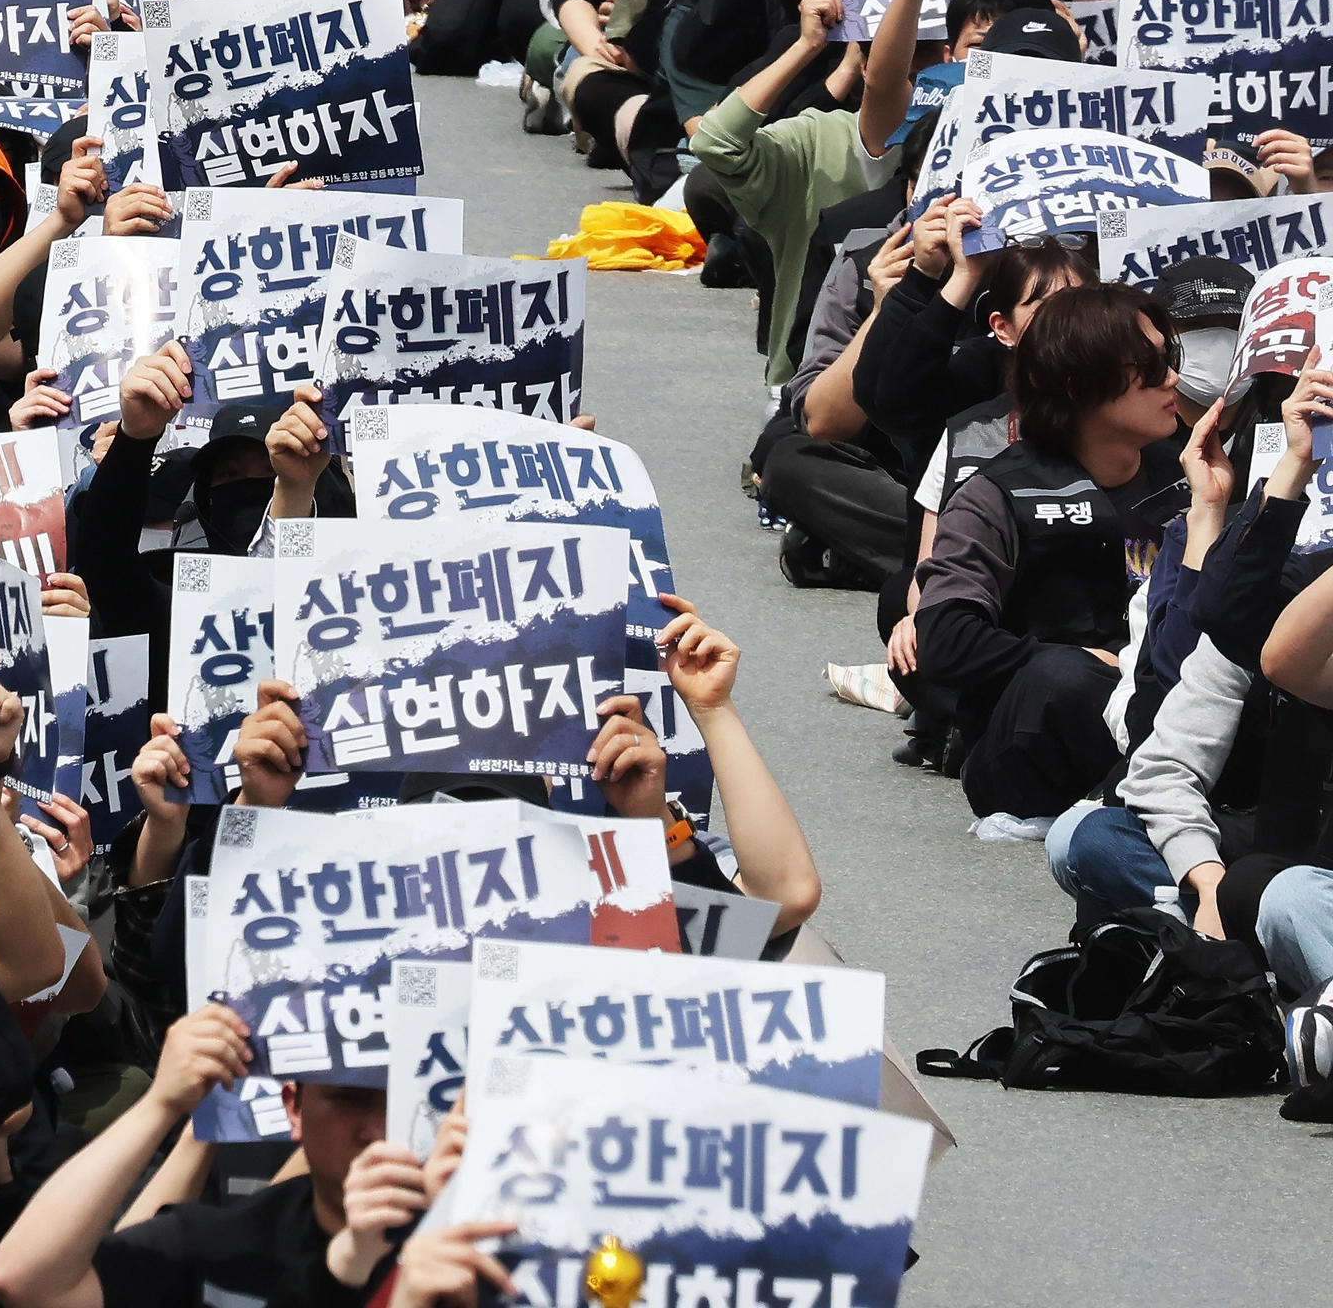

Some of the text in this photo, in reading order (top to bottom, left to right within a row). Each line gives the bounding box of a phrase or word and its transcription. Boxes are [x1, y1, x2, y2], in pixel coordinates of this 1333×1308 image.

[37, 71, 84, 86] 공동투쟁본부
[166, 0, 370, 100] 상한폐지
[194, 89, 415, 183] 실현하자
[978, 141, 1178, 194] 상한폐지
[332, 271, 570, 354] 상한폐지
[375, 439, 625, 521] 상한폐지
[1034, 501, 1094, 525] 투쟁
[295, 538, 584, 650] 상한폐지
[325, 656, 607, 771] 실현하자
[469, 758, 557, 774] 삼성전자노동조합
[232, 836, 541, 952] 상한폐지
[488, 1117, 865, 1213] 상한폐지
